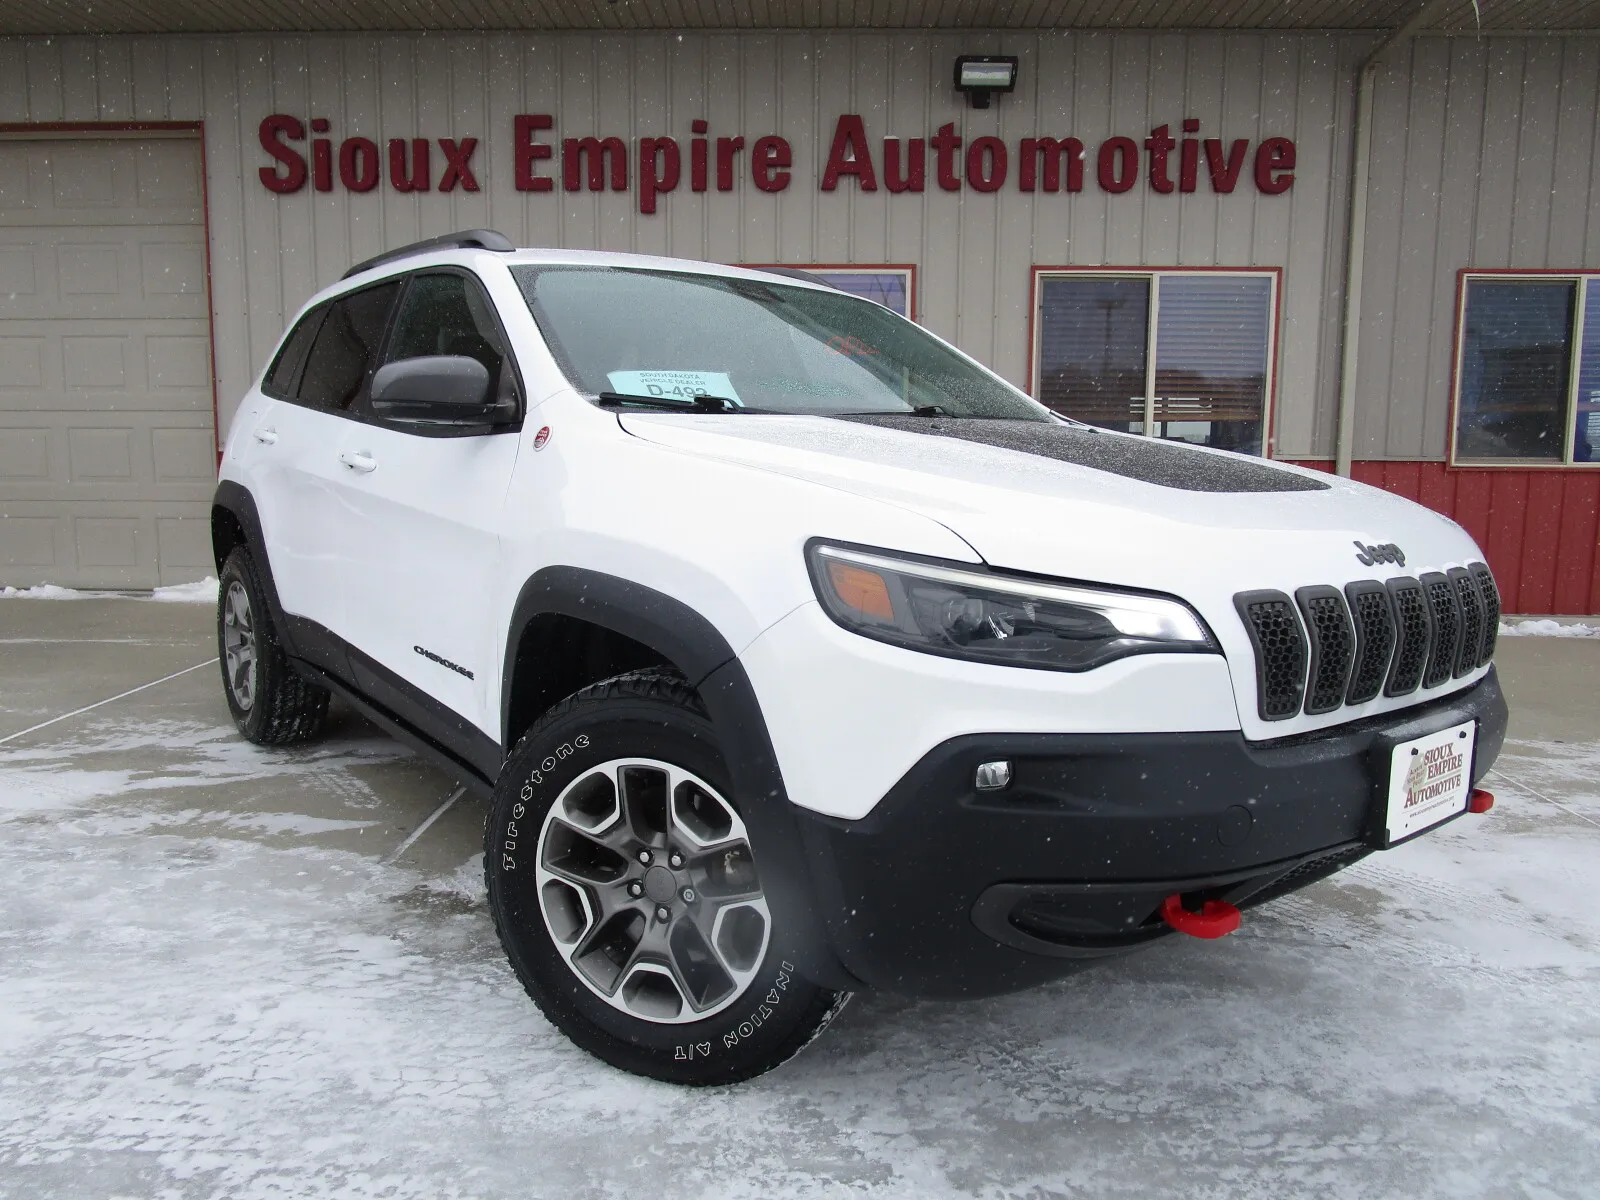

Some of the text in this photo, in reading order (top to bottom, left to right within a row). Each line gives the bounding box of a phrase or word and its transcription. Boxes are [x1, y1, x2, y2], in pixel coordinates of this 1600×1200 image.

[258, 113, 1296, 215] Sioux Empire Automotive
[1353, 540, 1406, 568] Jeep
[413, 645, 474, 681] CHEROKEE
[1423, 742, 1454, 766] SIOUX
[1427, 753, 1463, 780] EMPIRE
[502, 734, 590, 872] Firestone
[1404, 773, 1462, 809] AUTOMOTIVE
[674, 1041, 711, 1061] A/T
